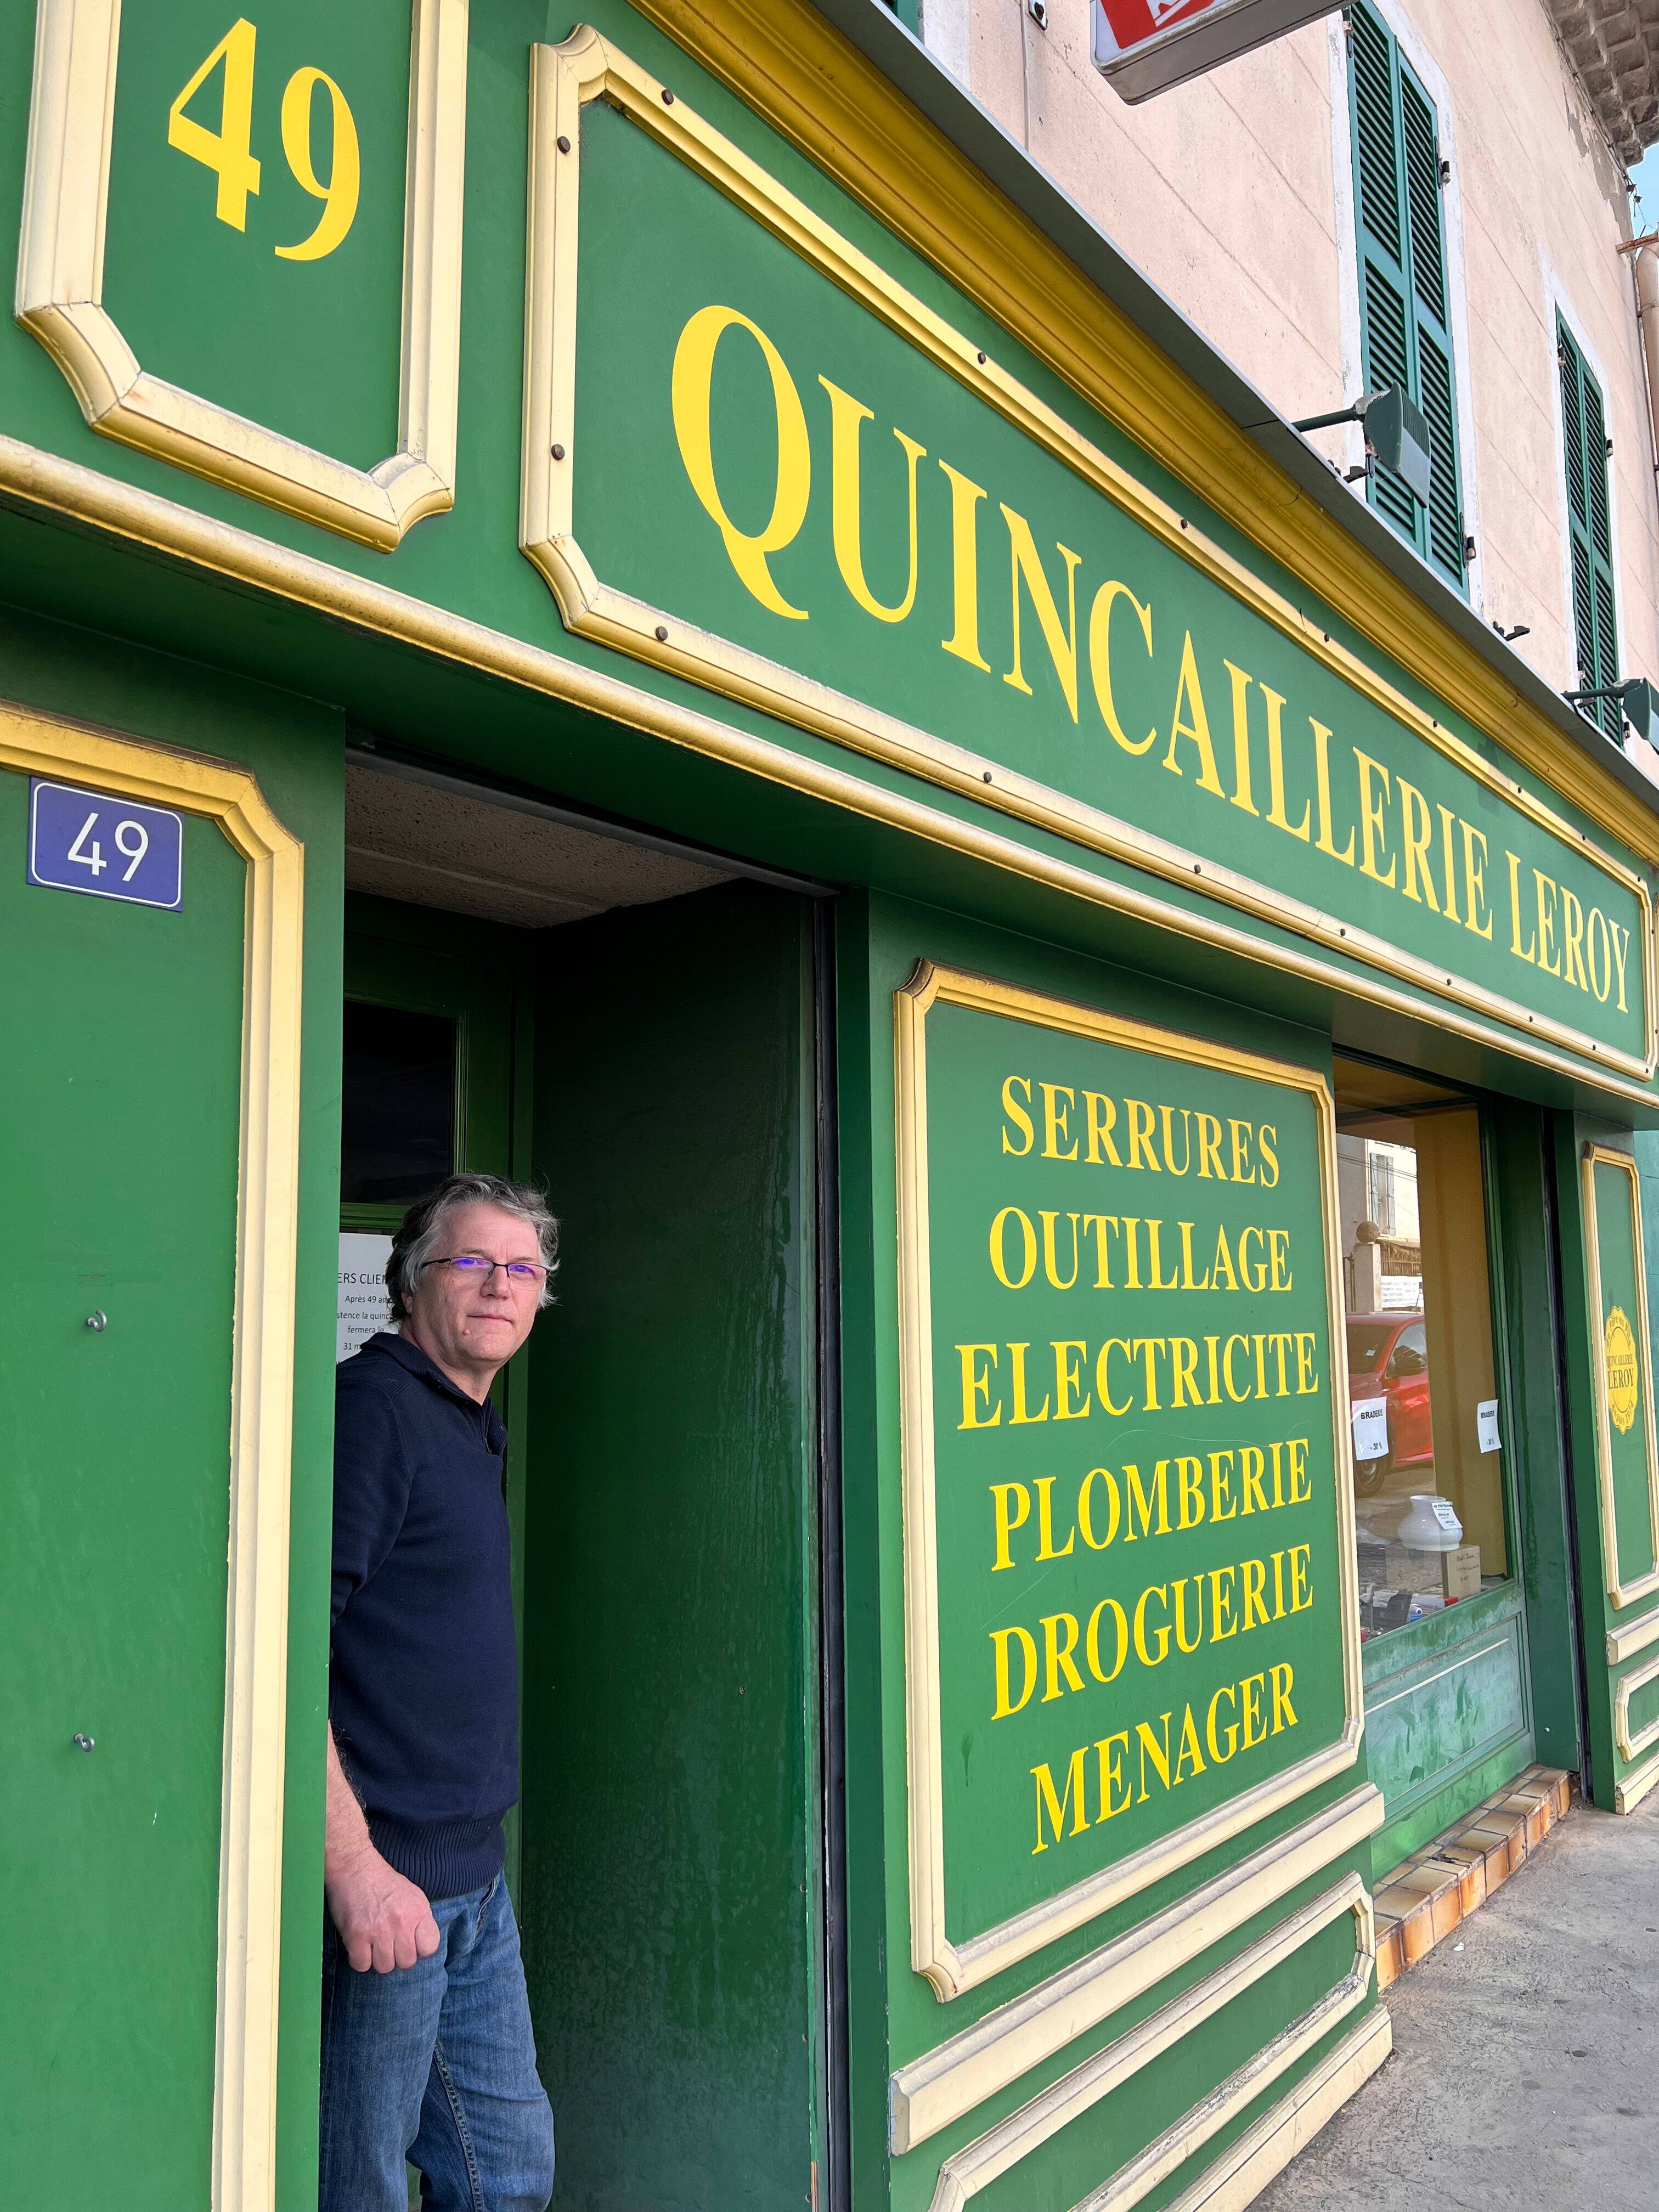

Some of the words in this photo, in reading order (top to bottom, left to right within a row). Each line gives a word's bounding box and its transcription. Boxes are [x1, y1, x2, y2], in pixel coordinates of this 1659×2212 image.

[168, 18, 360, 261] 49
[672, 305, 1492, 941] QUINCAILLERIE
[1505, 850, 1629, 1013] LEROY
[67, 812, 149, 882] 49
[1002, 1075, 1279, 1188] SERRURES
[989, 1207, 1292, 1293] OUTILLAGE
[345, 1295, 366, 1304] Après
[348, 1325, 376, 1334] fermera
[955, 1332, 1318, 1430] ELECTRICITE
[1361, 1409, 1383, 1419] BRADERIE
[1607, 1368, 1634, 1389] LEROY
[989, 1438, 1312, 1571] PLOMBERIE
[989, 1543, 1313, 1720] DROGUERIE
[1030, 1662, 1298, 1855] MENAGER
